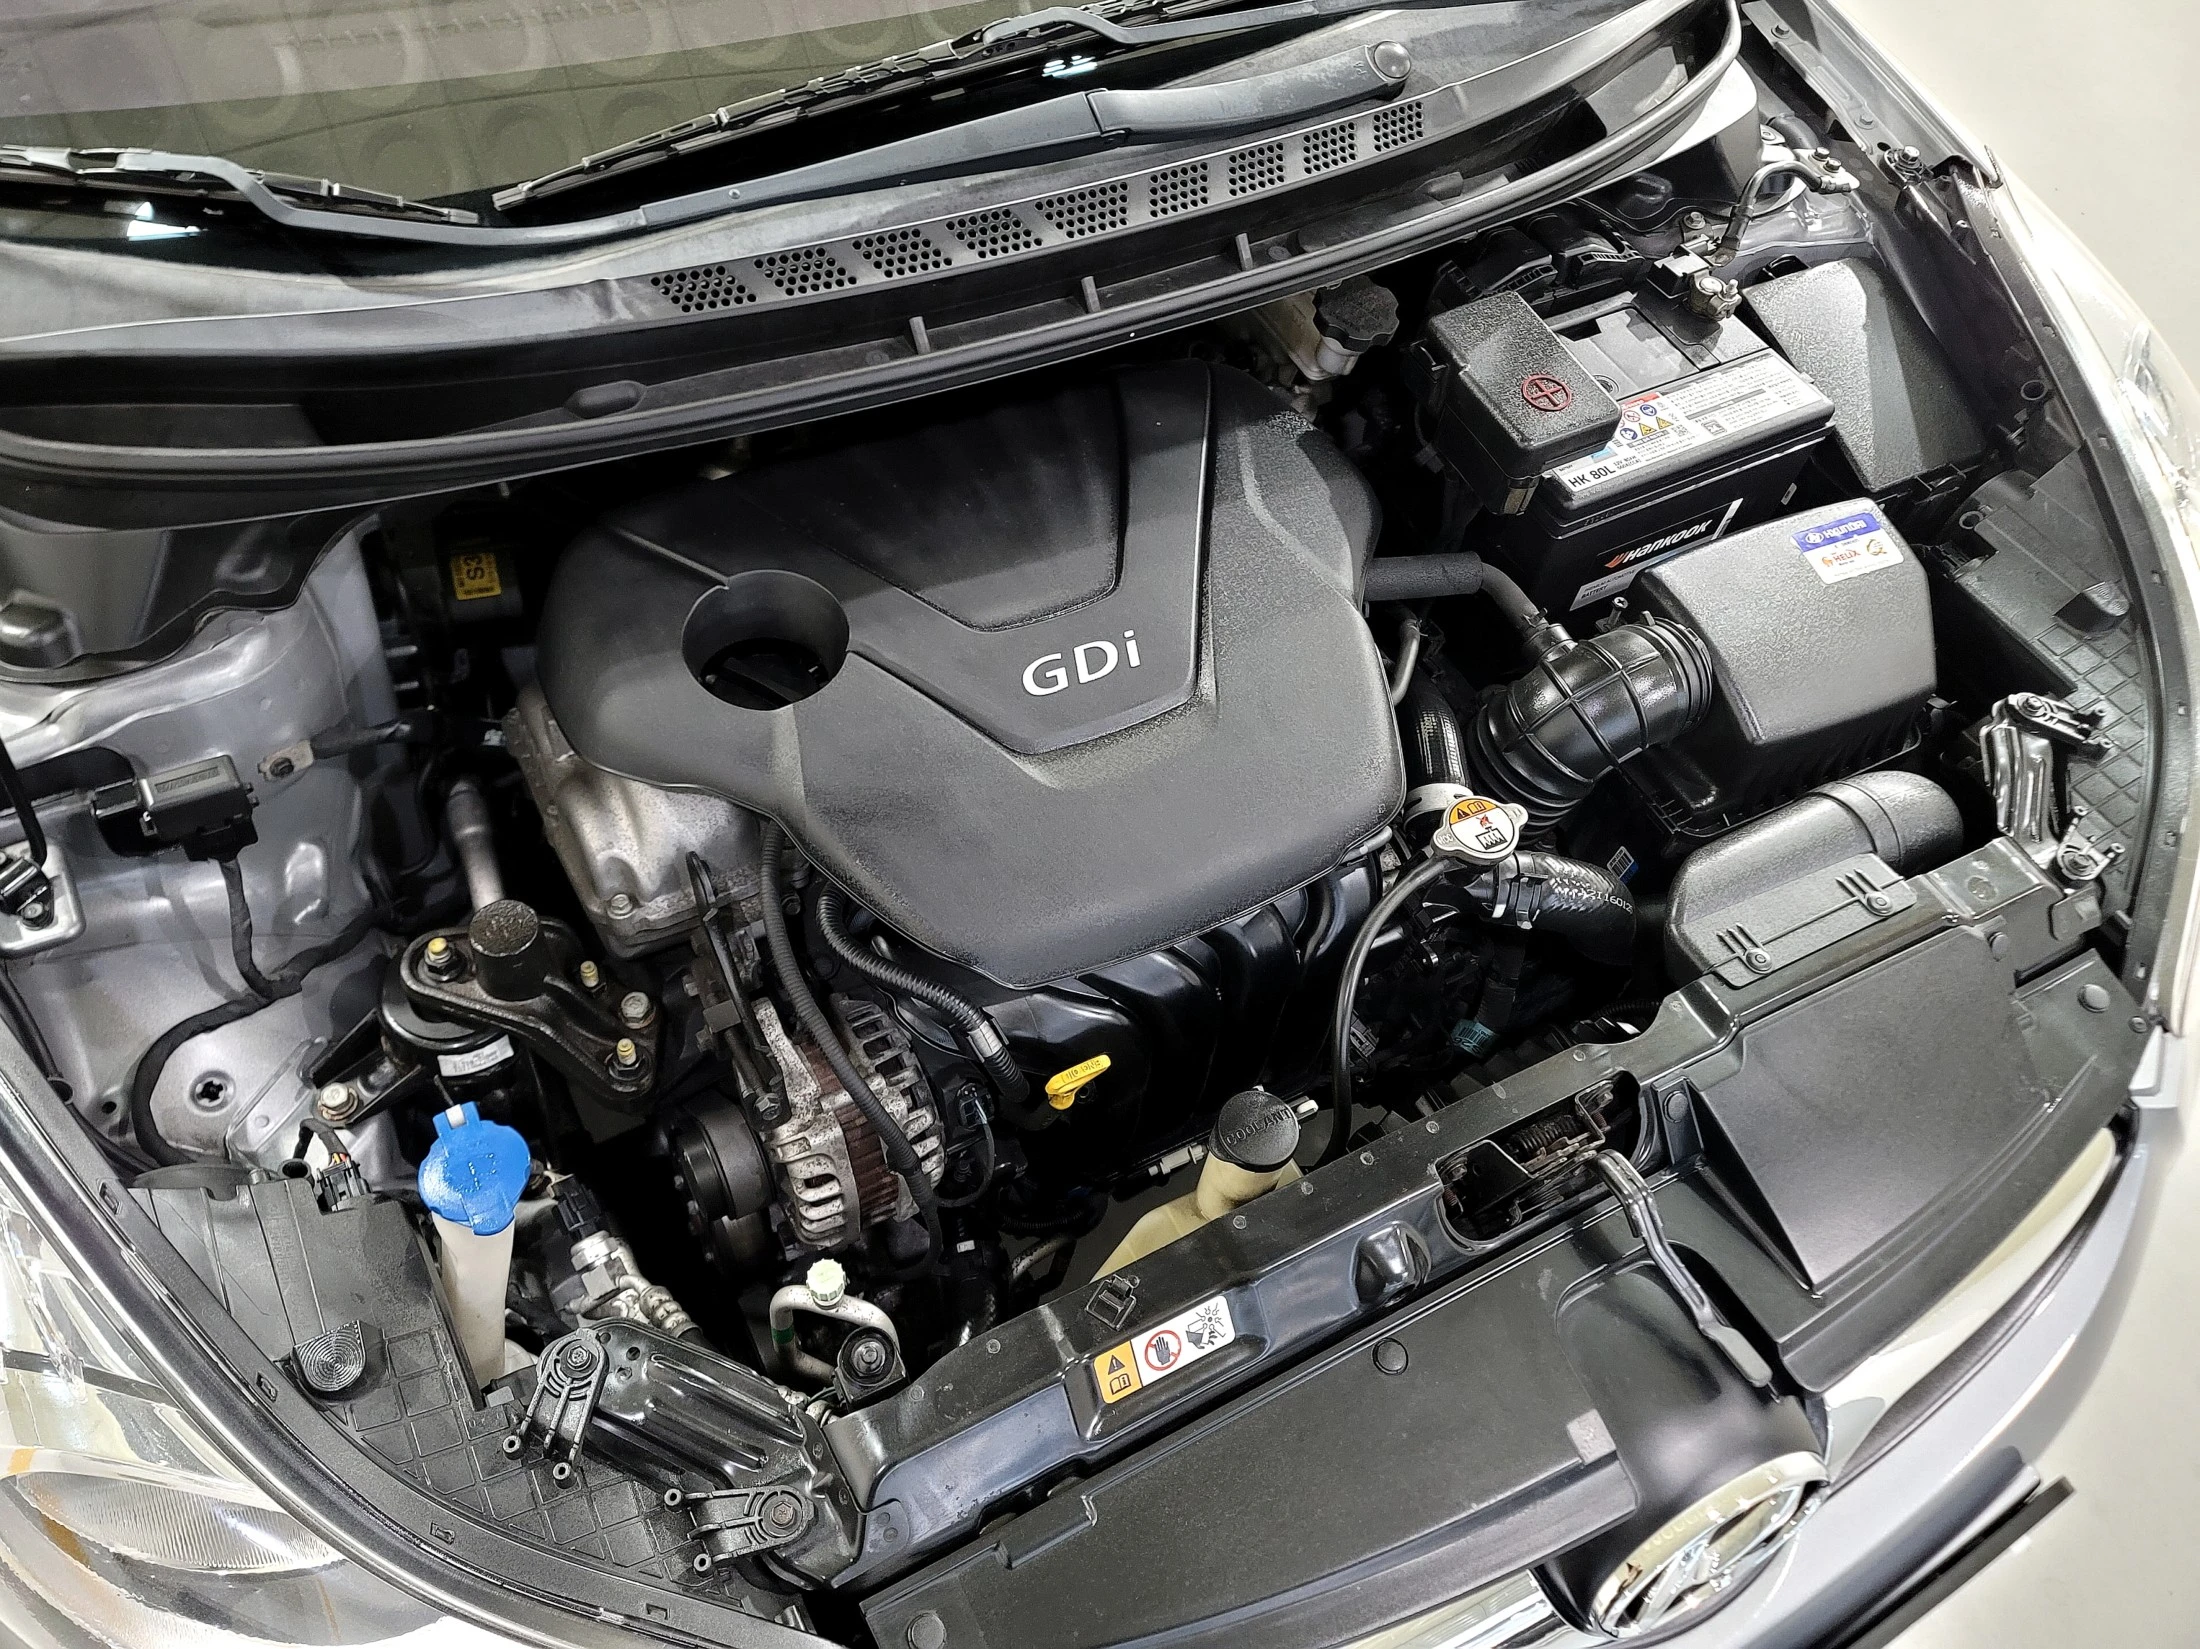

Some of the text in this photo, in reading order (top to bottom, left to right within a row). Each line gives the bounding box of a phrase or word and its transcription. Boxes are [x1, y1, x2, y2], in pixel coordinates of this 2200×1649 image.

[1568, 465, 1616, 487] HK 80L
[1022, 629, 1141, 696] GDi
